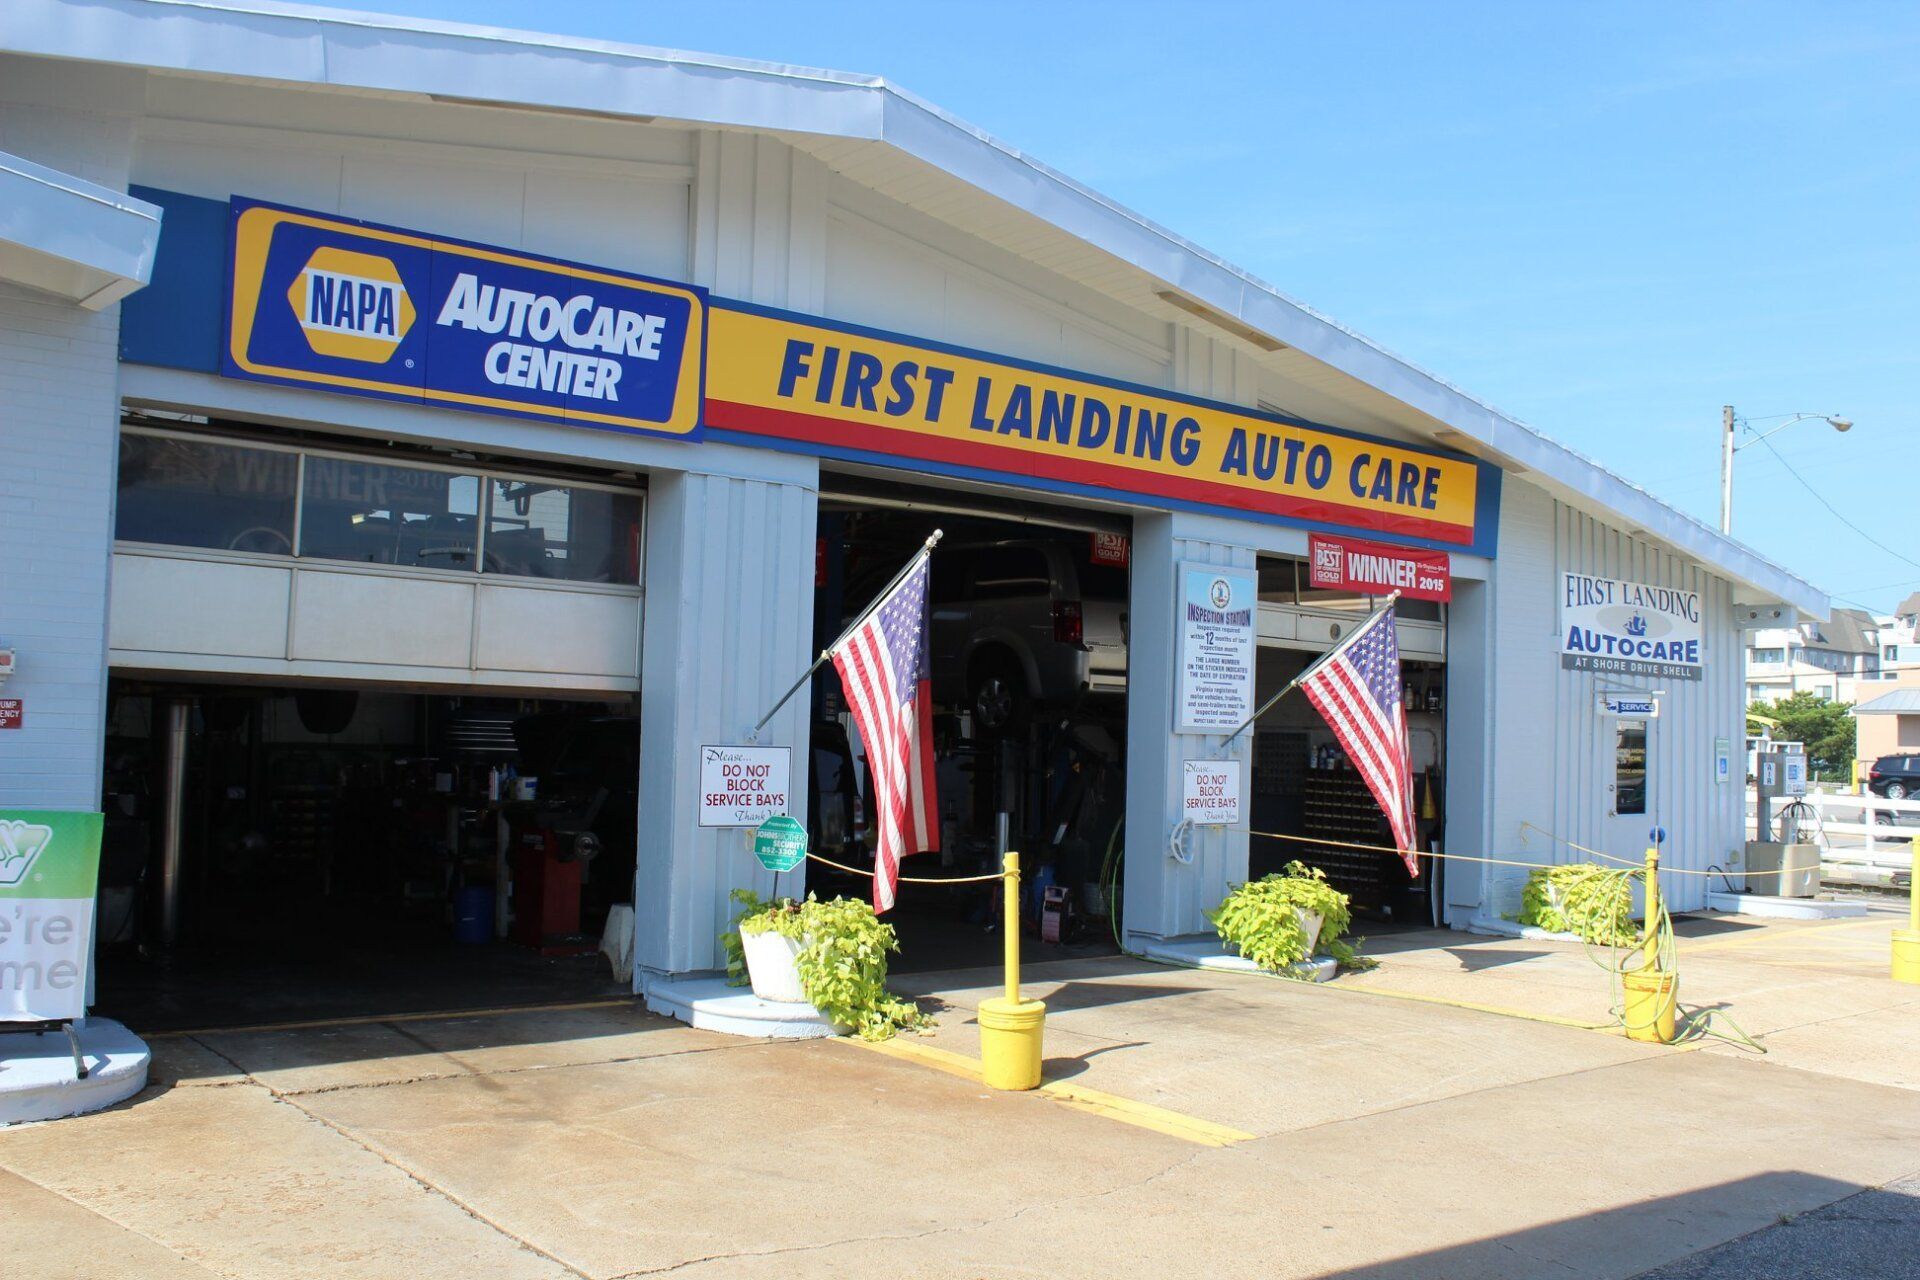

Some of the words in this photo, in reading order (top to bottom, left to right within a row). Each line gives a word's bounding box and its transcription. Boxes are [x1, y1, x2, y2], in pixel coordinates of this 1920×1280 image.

[310, 273, 395, 336] NAPA
[436, 272, 666, 361] AUTOCARE
[484, 342, 623, 402] CENTER
[777, 338, 955, 423] FIRST
[970, 376, 1201, 467] LANDING
[1220, 427, 1333, 490] AUTO
[1349, 453, 1442, 510] CARE
[1097, 548, 1120, 559] GOLD
[1317, 549, 1341, 568] BEST
[1317, 570, 1340, 580] GOLD
[1348, 552, 1416, 589] WINNER
[1419, 576, 1444, 592] 2015
[1565, 574, 1615, 608] FIRST
[1623, 583, 1699, 624] LANDING
[1187, 602, 1224, 625] INSPECTION
[1226, 608, 1251, 627] STATION
[1205, 631, 1214, 645] 12
[1566, 625, 1699, 663] AUTOCARE
[1575, 657, 1587, 668] AT
[1593, 659, 1626, 671] SHORE
[1630, 663, 1659, 674] DRIVE
[1663, 665, 1692, 677] SHELL
[0, 700, 17, 709] UMP
[0, 709, 20, 718] ENCY
[722, 764, 742, 777] DO
[746, 765, 771, 777] NOT
[727, 778, 765, 791] BLOCK
[1196, 774, 1209, 785] DO
[1211, 774, 1227, 785] NOT
[1199, 786, 1224, 797] BLOCK
[705, 793, 752, 806] SERVICE
[756, 793, 785, 806] BAYS
[1186, 798, 1215, 808] SERVICE
[1218, 798, 1236, 808] BAYS
[734, 810, 766, 821] Thank
[773, 839, 805, 849] SECURITY
